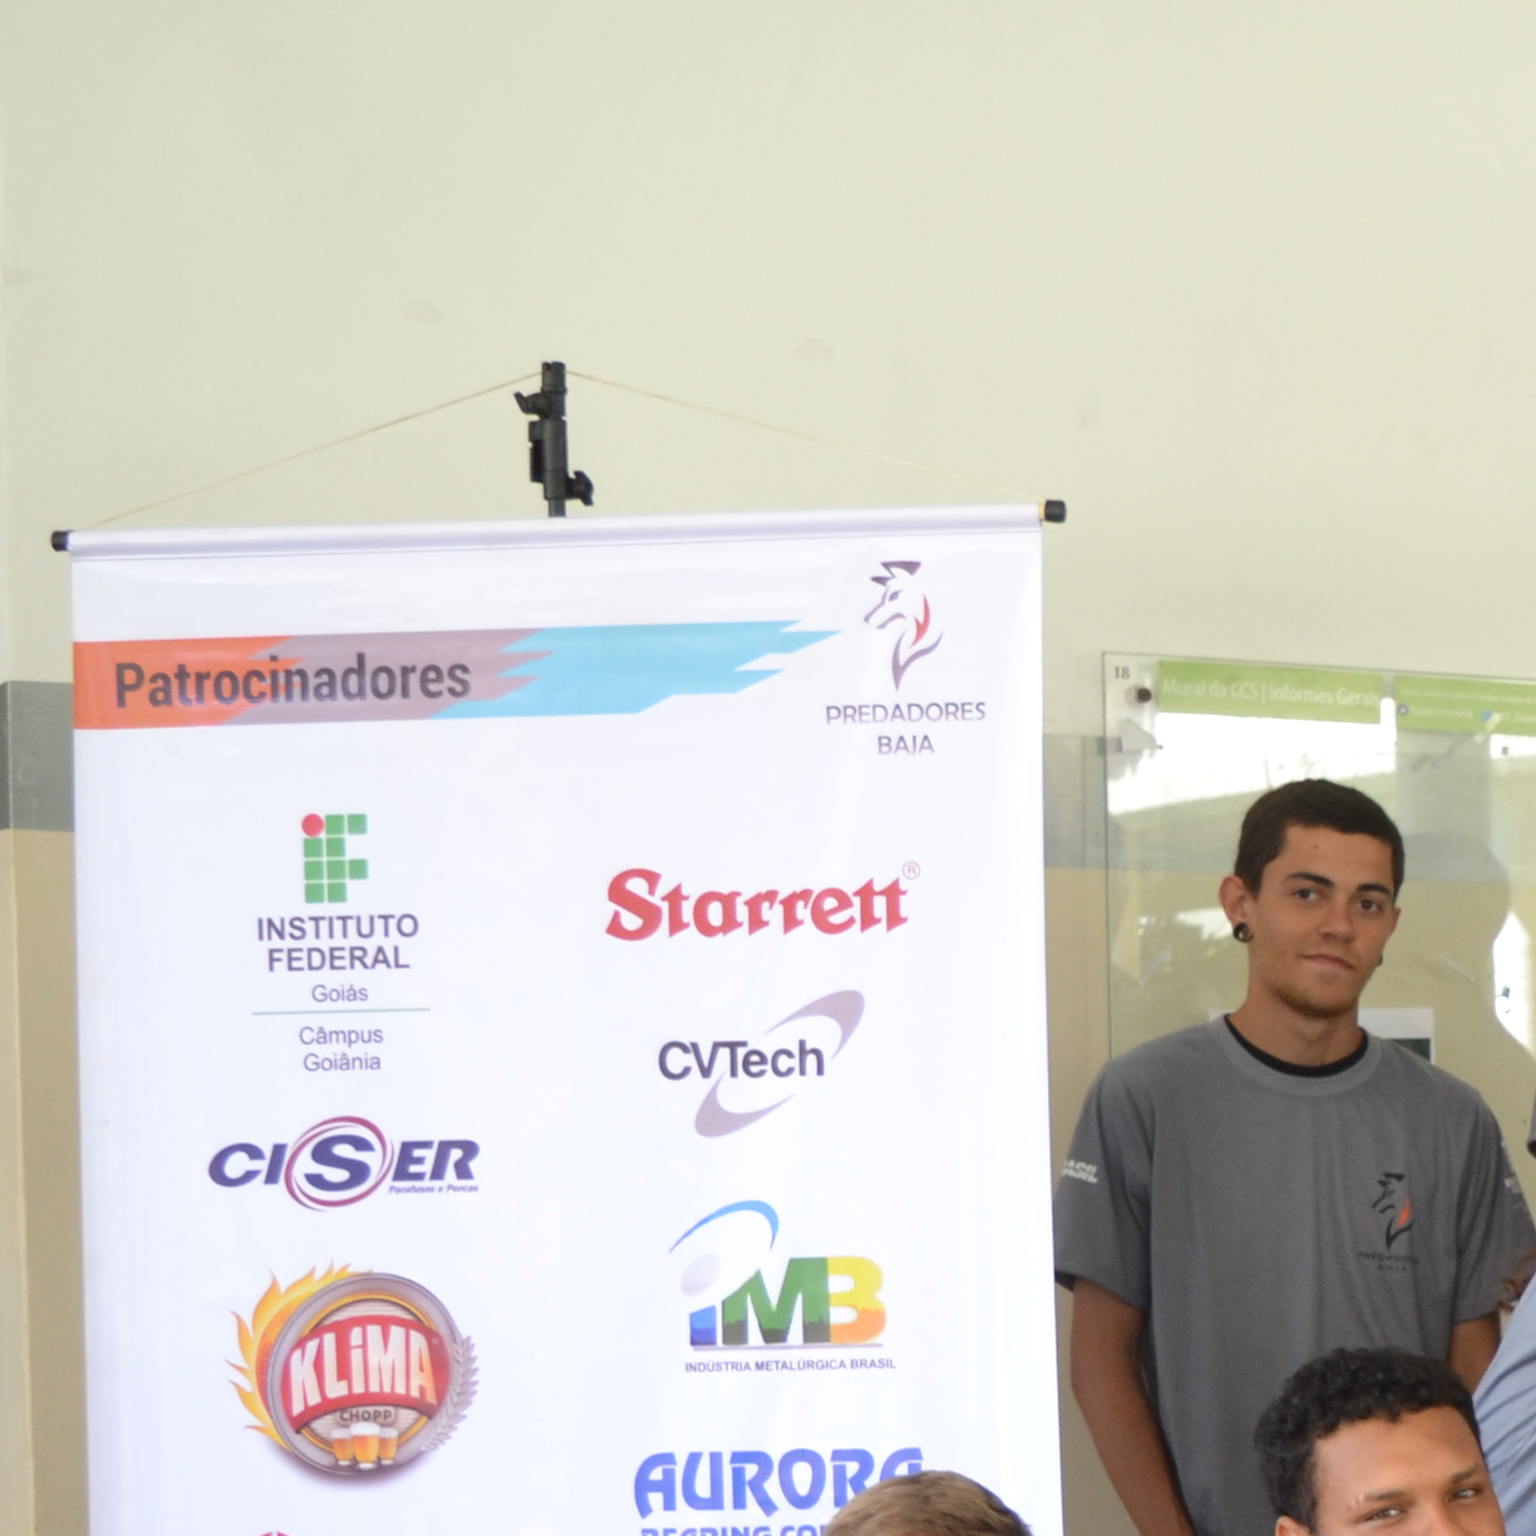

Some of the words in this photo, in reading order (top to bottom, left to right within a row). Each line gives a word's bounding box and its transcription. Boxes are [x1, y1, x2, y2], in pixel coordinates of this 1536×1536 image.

[115, 653, 472, 708] Patrocinadores
[825, 701, 987, 726] PREDADORES
[877, 734, 936, 757] BAJA
[604, 867, 910, 942] Starrett
[256, 913, 420, 942] INSTITUTO
[267, 945, 411, 972] FEDERAL
[311, 983, 369, 1003] Goiás
[298, 1025, 384, 1049] Câmpus
[302, 1052, 382, 1073] Goiânia
[657, 1039, 826, 1082] CVTech
[207, 1133, 481, 1193] CISER
[684, 1358, 753, 1374] INDÚSTRIA
[753, 1357, 848, 1373] METALÚRGICA
[849, 1356, 898, 1371] BRASIL
[338, 1407, 394, 1424] CHOPP
